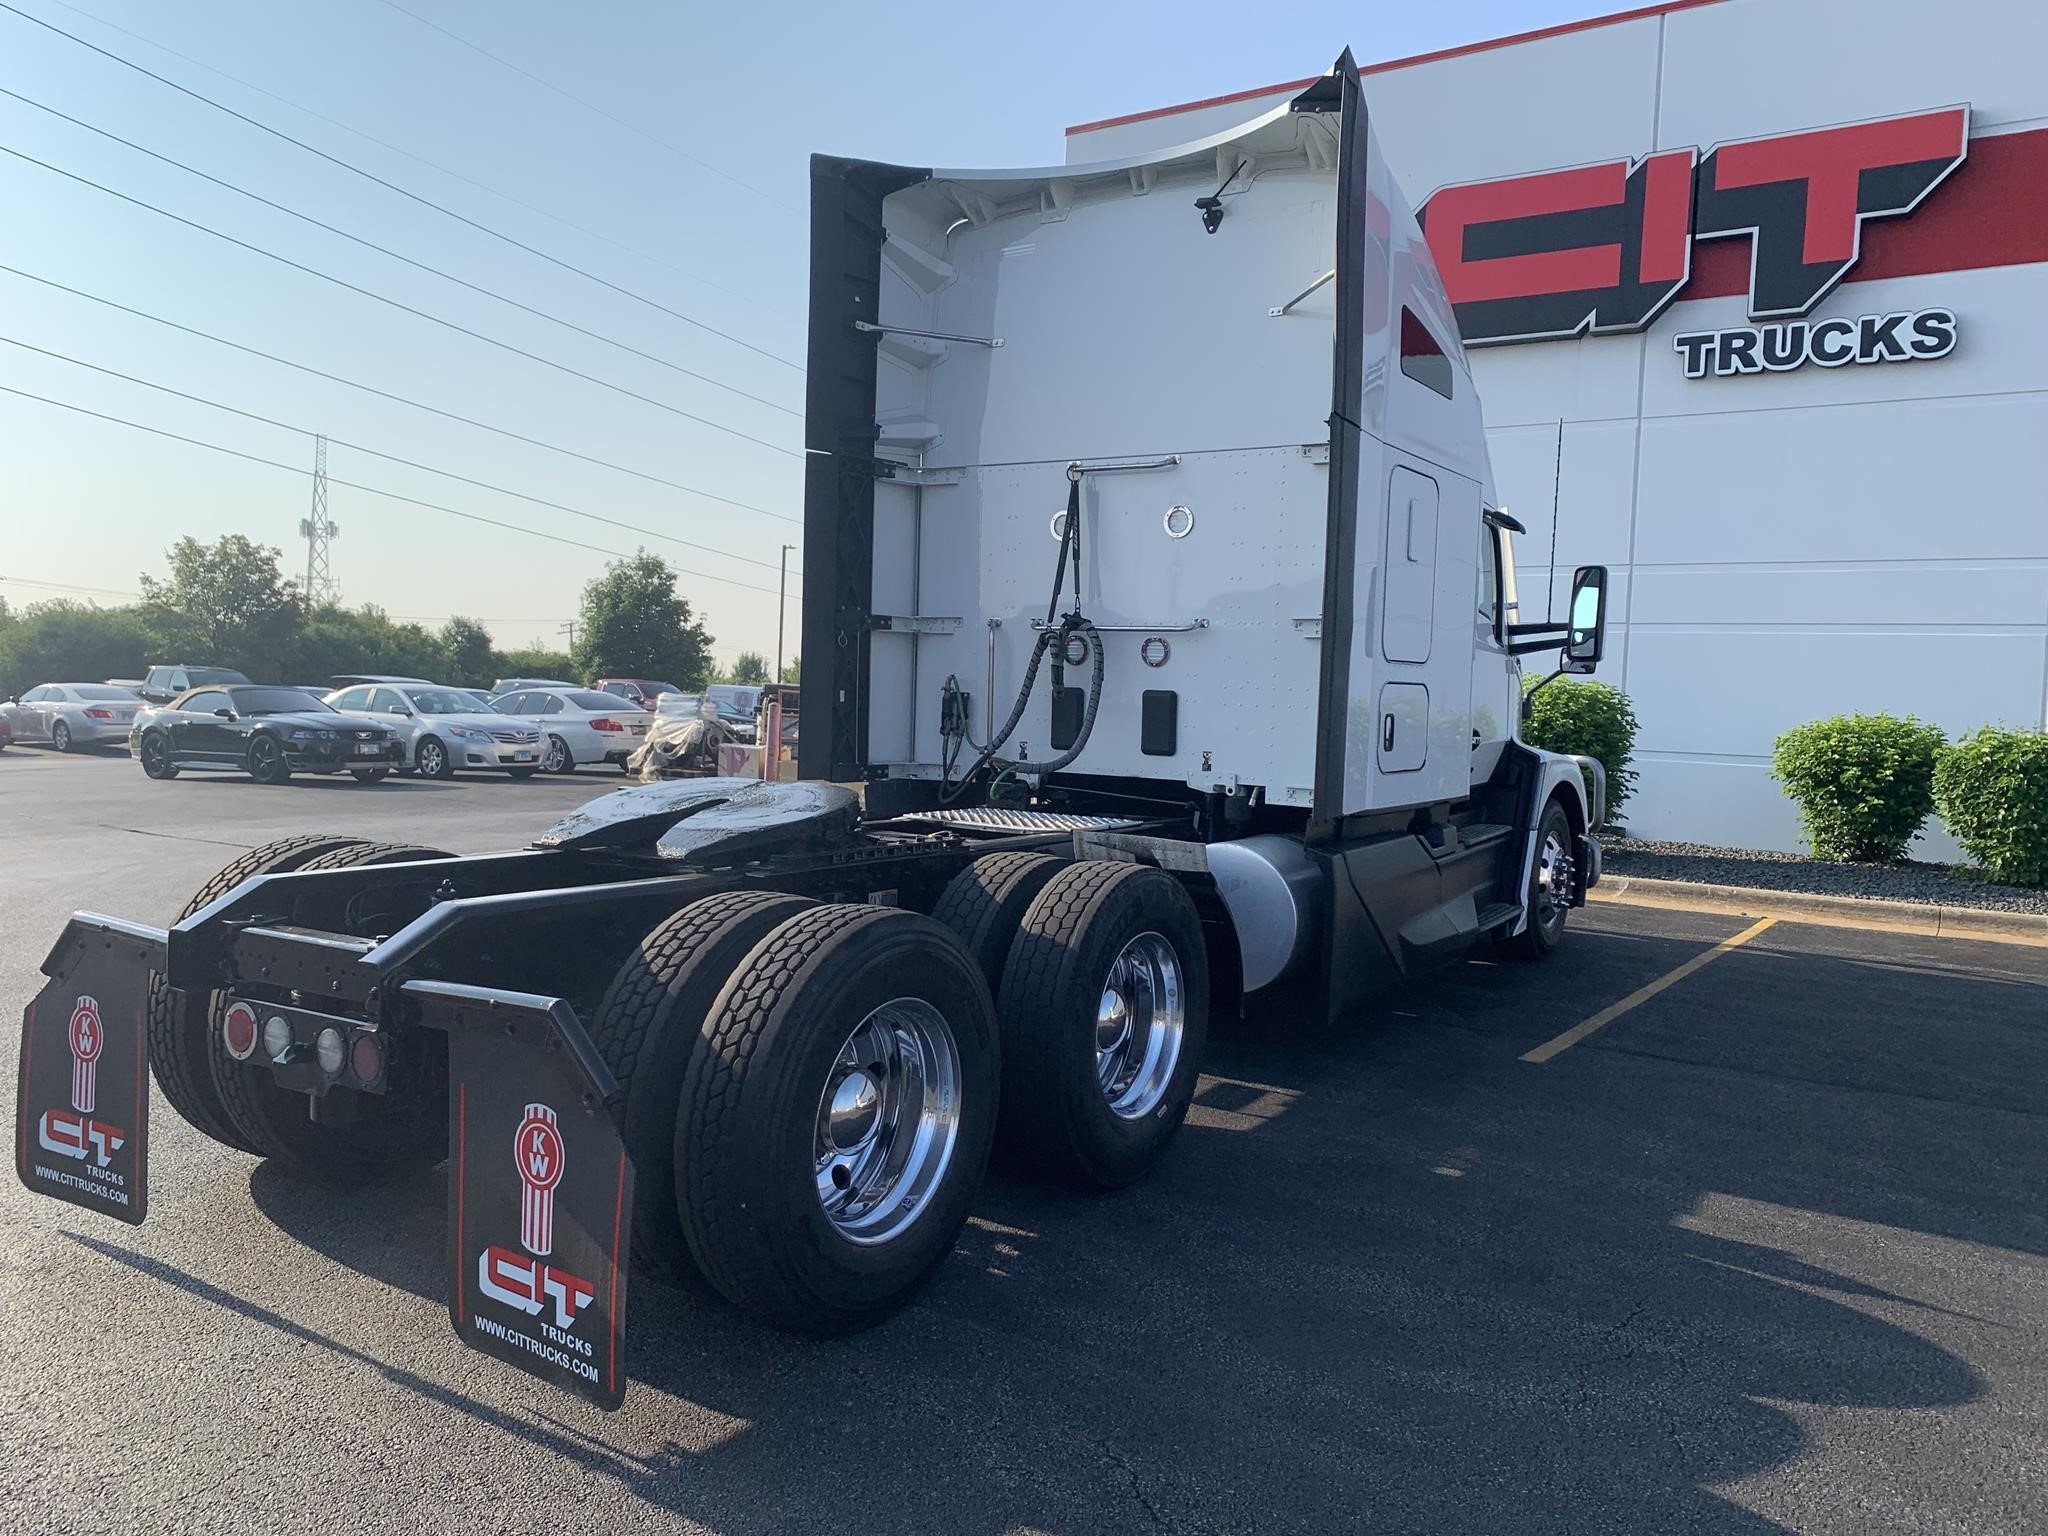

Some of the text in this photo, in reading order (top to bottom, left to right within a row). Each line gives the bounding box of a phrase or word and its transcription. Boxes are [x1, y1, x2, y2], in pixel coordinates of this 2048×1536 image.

[1416, 104, 1970, 344] CIT
[1675, 309, 1957, 377] TRUCKS
[39, 1108, 125, 1168] CIT
[35, 1164, 128, 1206] WWW.CITTRUCKS.COM
[86, 1164, 124, 1186] TRUCKS
[479, 1244, 594, 1330] CIT
[474, 1314, 599, 1384] WWW.CITTRUCKS.COM
[540, 1322, 593, 1356] TRUCKS
